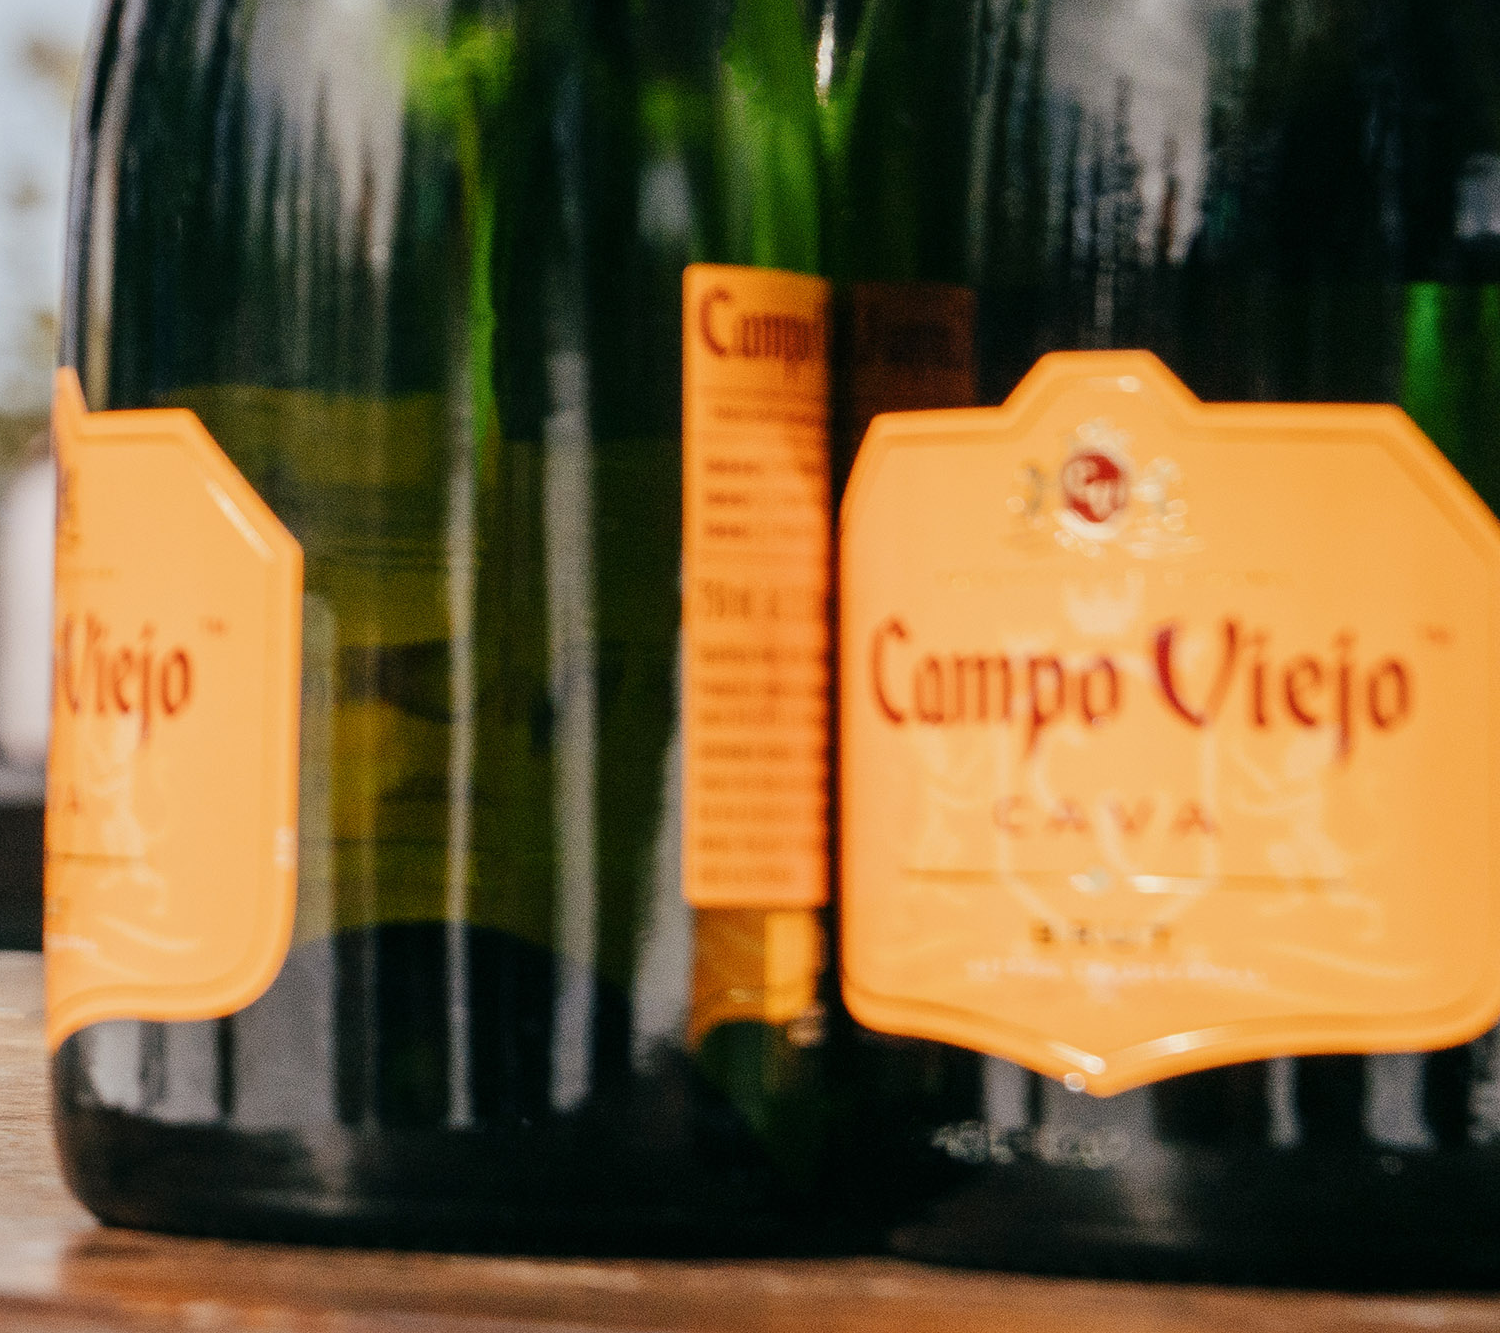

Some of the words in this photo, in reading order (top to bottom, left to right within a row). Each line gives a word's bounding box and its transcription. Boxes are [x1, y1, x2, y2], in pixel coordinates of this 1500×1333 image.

[869, 614, 1122, 765] Campo
[1149, 612, 1412, 768] Viejo
[992, 794, 1219, 835] CAVA
